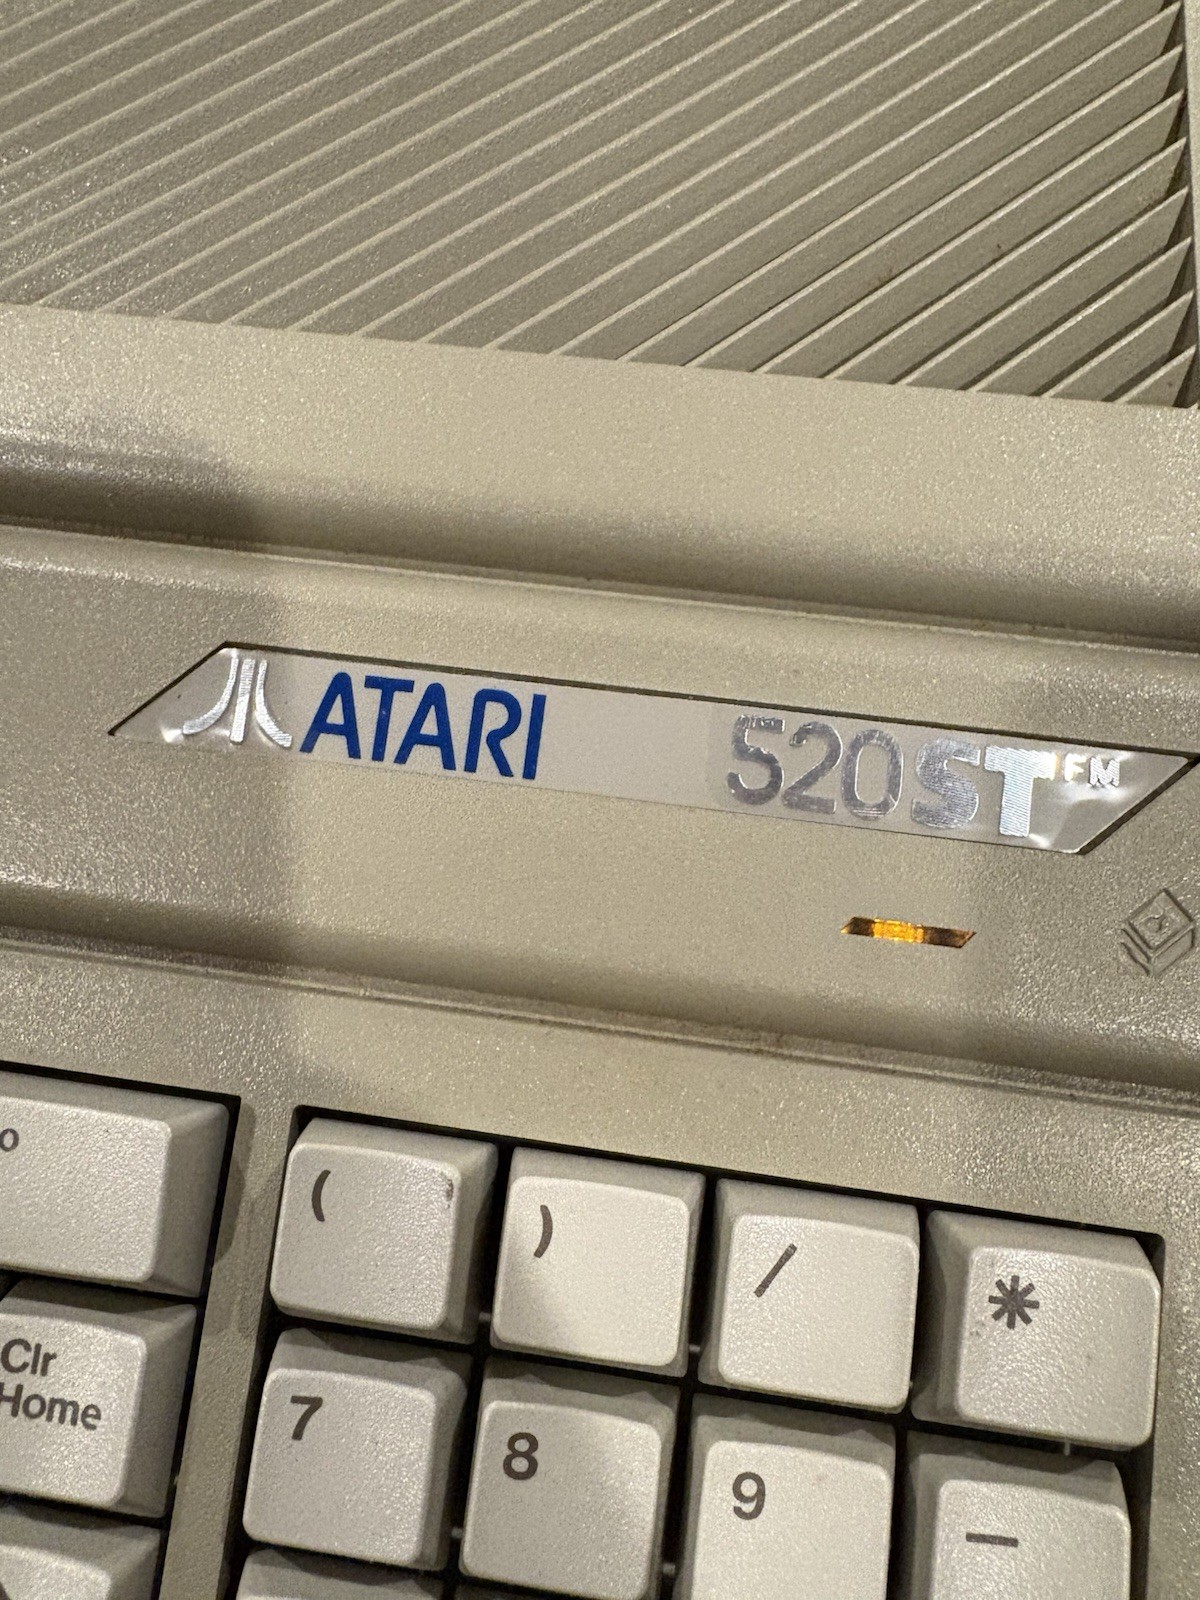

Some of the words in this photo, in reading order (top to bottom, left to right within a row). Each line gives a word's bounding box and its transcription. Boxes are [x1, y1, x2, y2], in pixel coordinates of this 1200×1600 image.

[300, 672, 547, 780] ATARI
[311, 1169, 331, 1222] (
[533, 1204, 553, 1258] )
[754, 1243, 798, 1298] /
[0, 1338, 57, 1377] Clr
[0, 1383, 102, 1431] Home
[290, 1396, 323, 1440] 7
[503, 1432, 539, 1481] 8
[732, 1472, 766, 1521] 9
